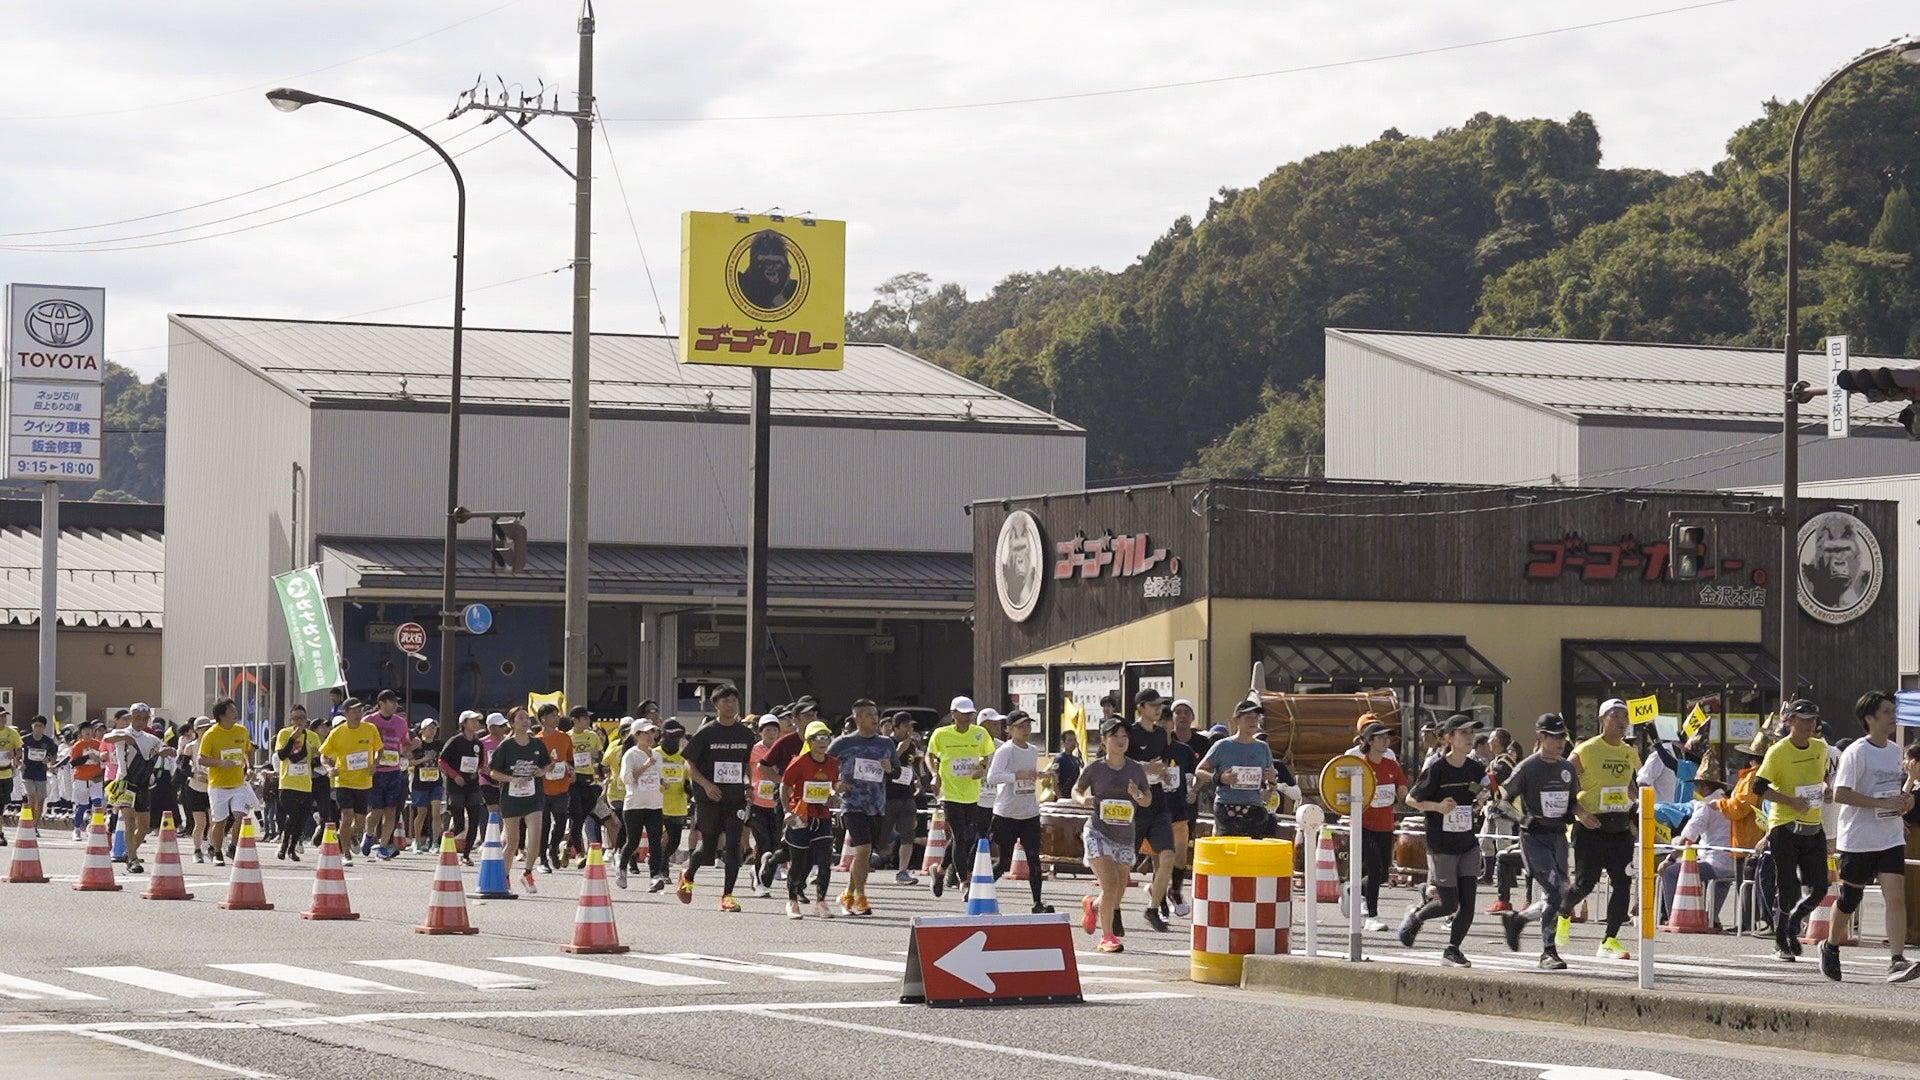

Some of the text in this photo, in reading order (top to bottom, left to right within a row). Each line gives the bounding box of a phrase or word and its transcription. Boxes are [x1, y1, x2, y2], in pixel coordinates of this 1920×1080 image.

[18, 352, 97, 370] TOYOTA
[37, 390, 80, 401] ネッツ石川
[34, 401, 82, 412] 田上もりの里
[24, 420, 90, 434] クイック車検
[32, 439, 83, 454] 鈑金修理
[18, 460, 94, 475] 9:15 18:00
[1699, 585, 1767, 606] 金沢本店
[1635, 704, 1654, 717] KM
